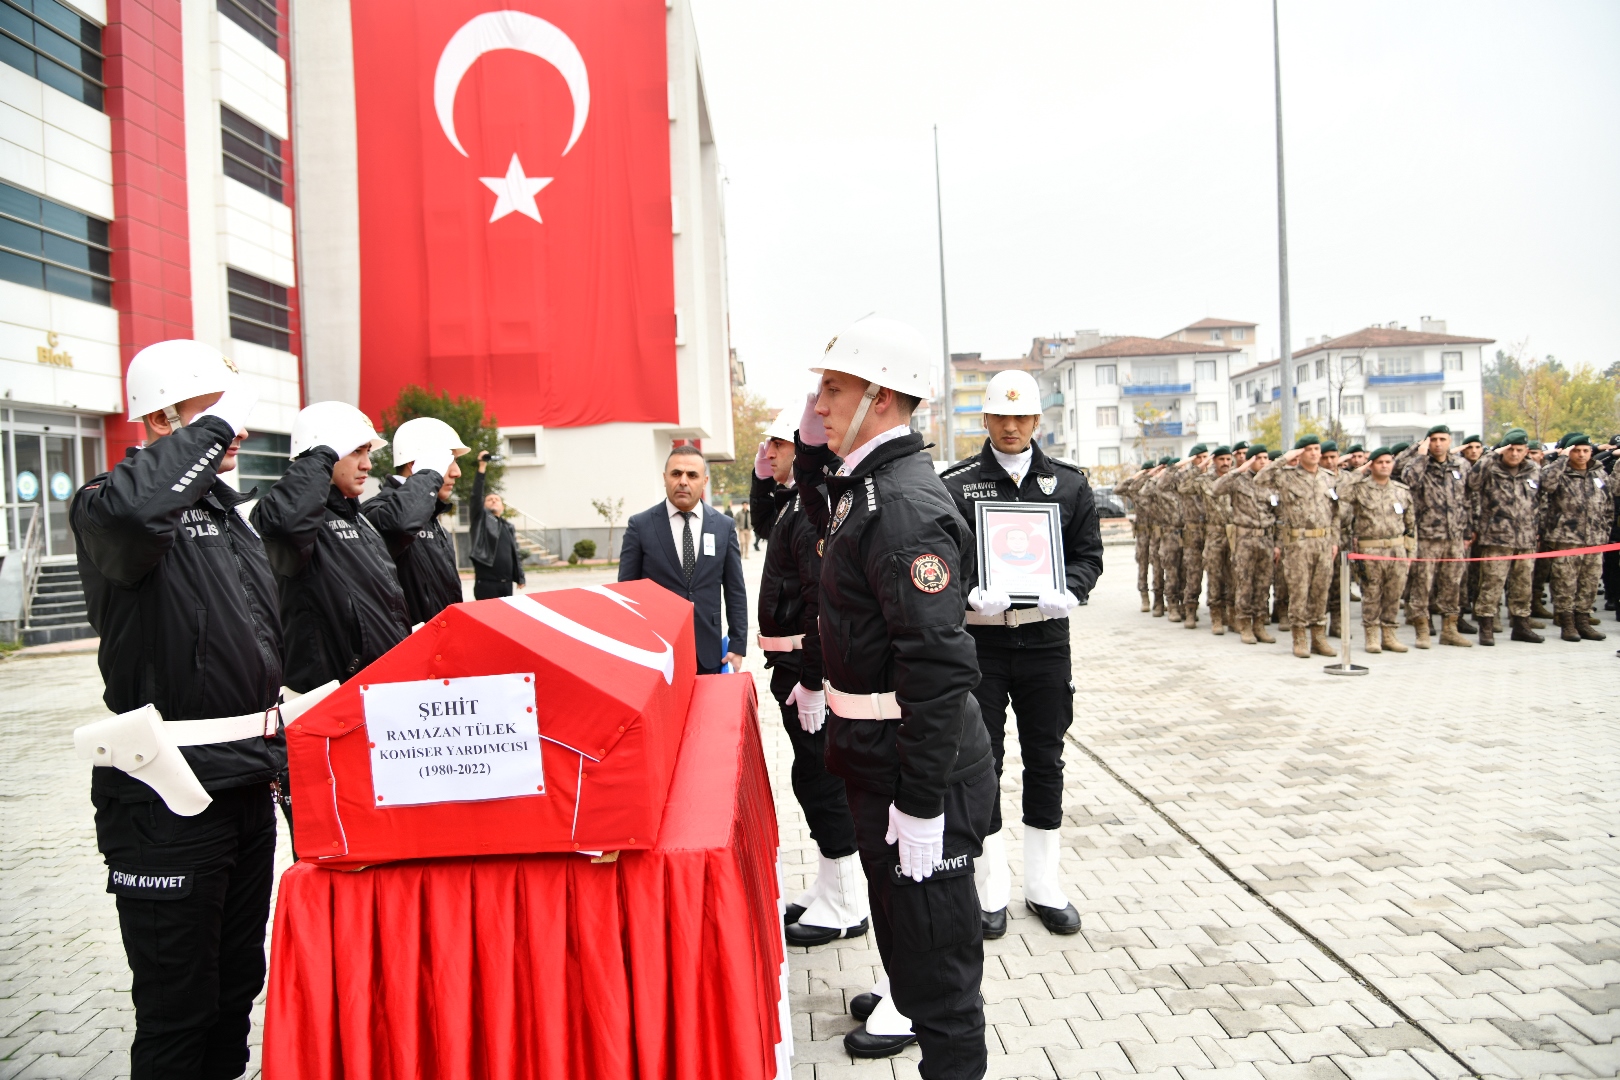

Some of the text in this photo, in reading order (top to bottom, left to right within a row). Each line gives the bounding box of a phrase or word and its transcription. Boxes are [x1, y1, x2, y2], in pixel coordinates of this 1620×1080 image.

[47, 330, 60, 348] C
[37, 345, 74, 368] Blok
[418, 696, 479, 721] ŞEHİT
[386, 722, 517, 742] RAMAZAN TÜLEK
[379, 741, 529, 760] KOMİSER YARDIMCISI
[418, 762, 492, 779] (1980-2022)
[112, 870, 186, 888] ÇEVİK KUVVET
